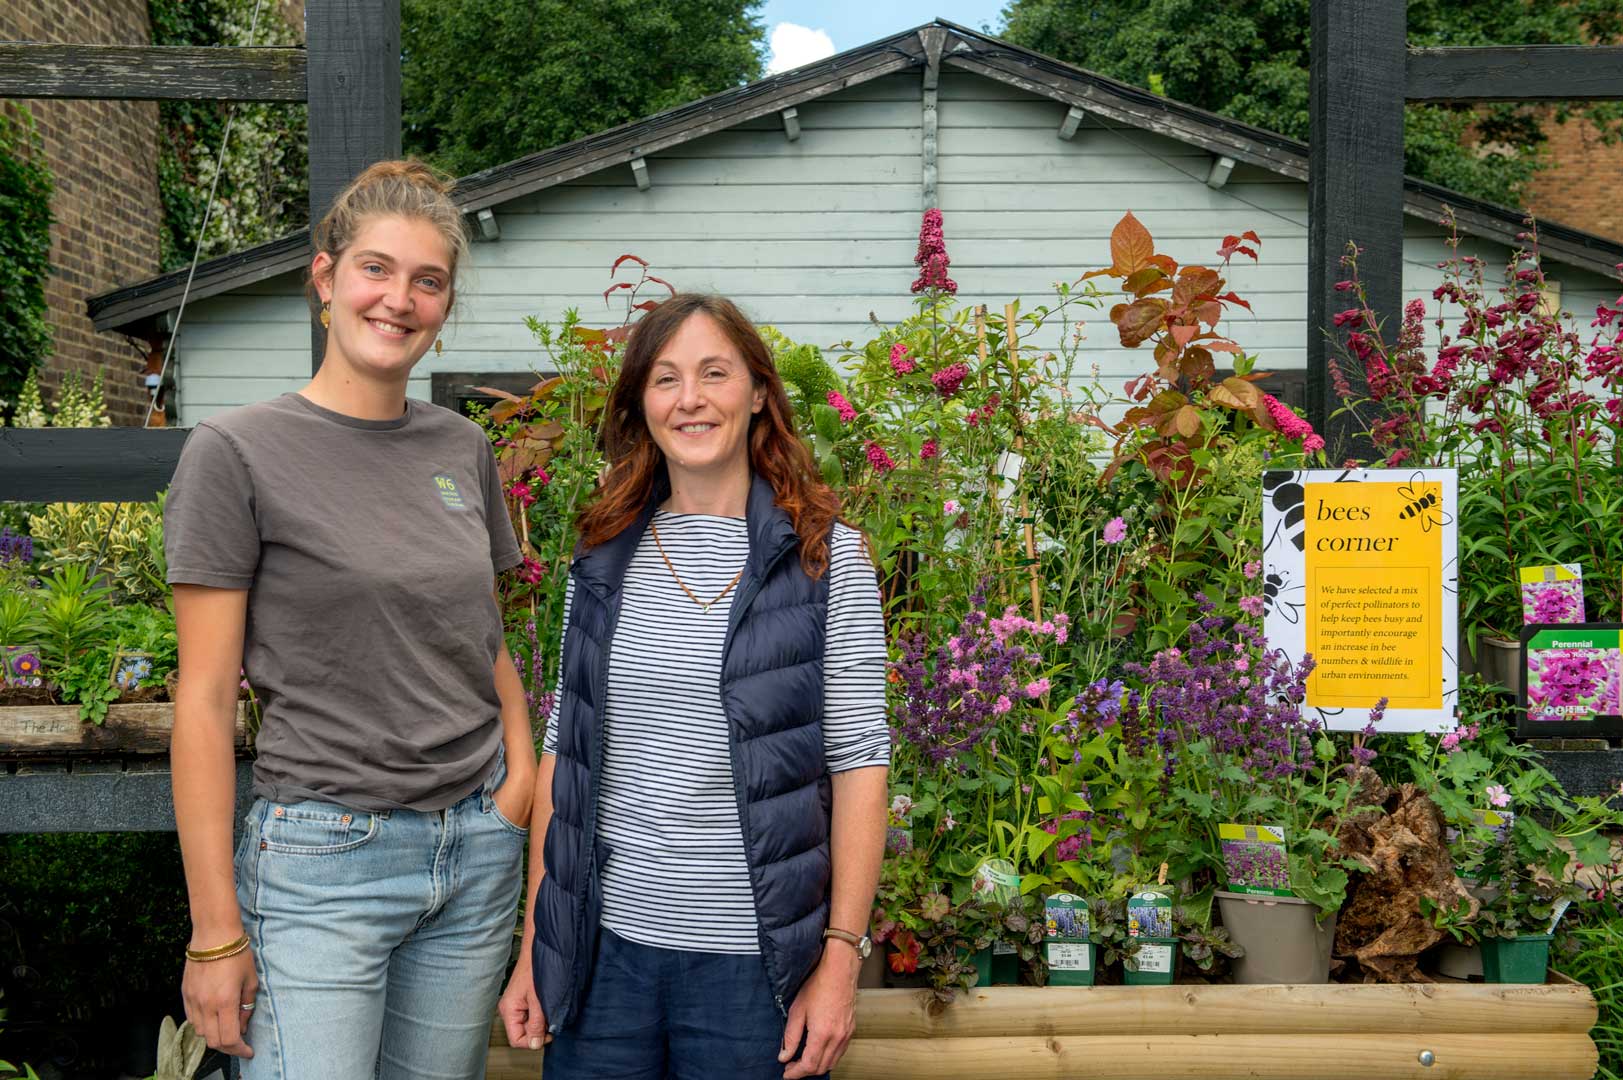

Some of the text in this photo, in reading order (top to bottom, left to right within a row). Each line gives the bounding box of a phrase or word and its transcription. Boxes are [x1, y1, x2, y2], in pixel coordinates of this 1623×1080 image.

[434, 476, 455, 491] W6
[1317, 499, 1371, 521] bees
[1316, 537, 1399, 551] corner
[1321, 585, 1335, 594] We
[1336, 586, 1356, 594] have
[1358, 586, 1392, 594] selected
[1320, 600, 1330, 608] of
[1330, 600, 1361, 610] perfect
[1362, 601, 1409, 610] pollinators
[1321, 614, 1423, 624] help keep bees busy and
[1321, 629, 1418, 639] importantly encourage
[1333, 643, 1368, 651] increase
[1370, 643, 1379, 651] in
[1381, 643, 1396, 651] bee
[1552, 640, 1593, 649] Perennial
[1321, 657, 1358, 665] numbers
[1361, 657, 1368, 665] &
[1371, 657, 1402, 665] wildlife
[1321, 671, 1346, 679] urban
[20, 719, 46, 734] The
